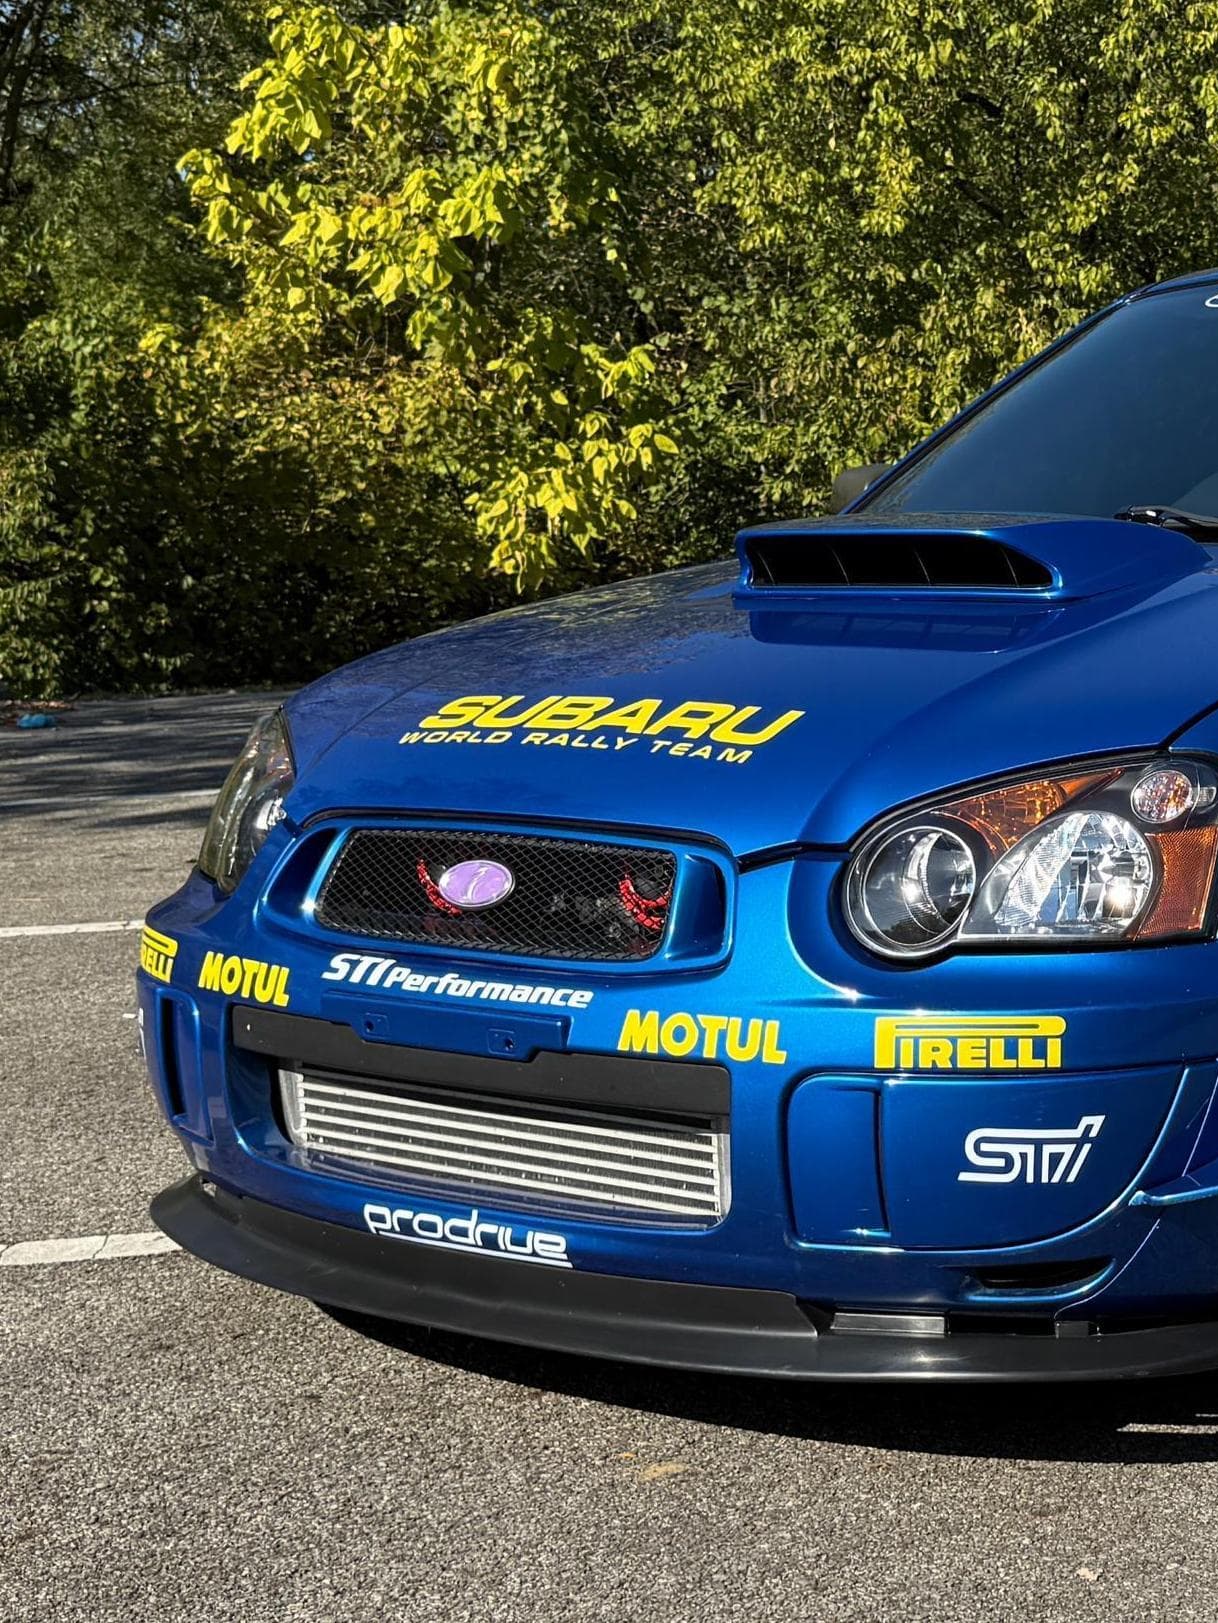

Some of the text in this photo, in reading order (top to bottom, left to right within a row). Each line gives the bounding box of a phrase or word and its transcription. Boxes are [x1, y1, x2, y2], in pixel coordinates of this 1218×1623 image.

[419, 695, 806, 745] SUBARU
[399, 730, 753, 764] WORLD RALLY TEAM
[198, 951, 290, 1007] MOTUL
[617, 1009, 787, 1064] MOTUL
[874, 1016, 1067, 1068] PIRELLI
